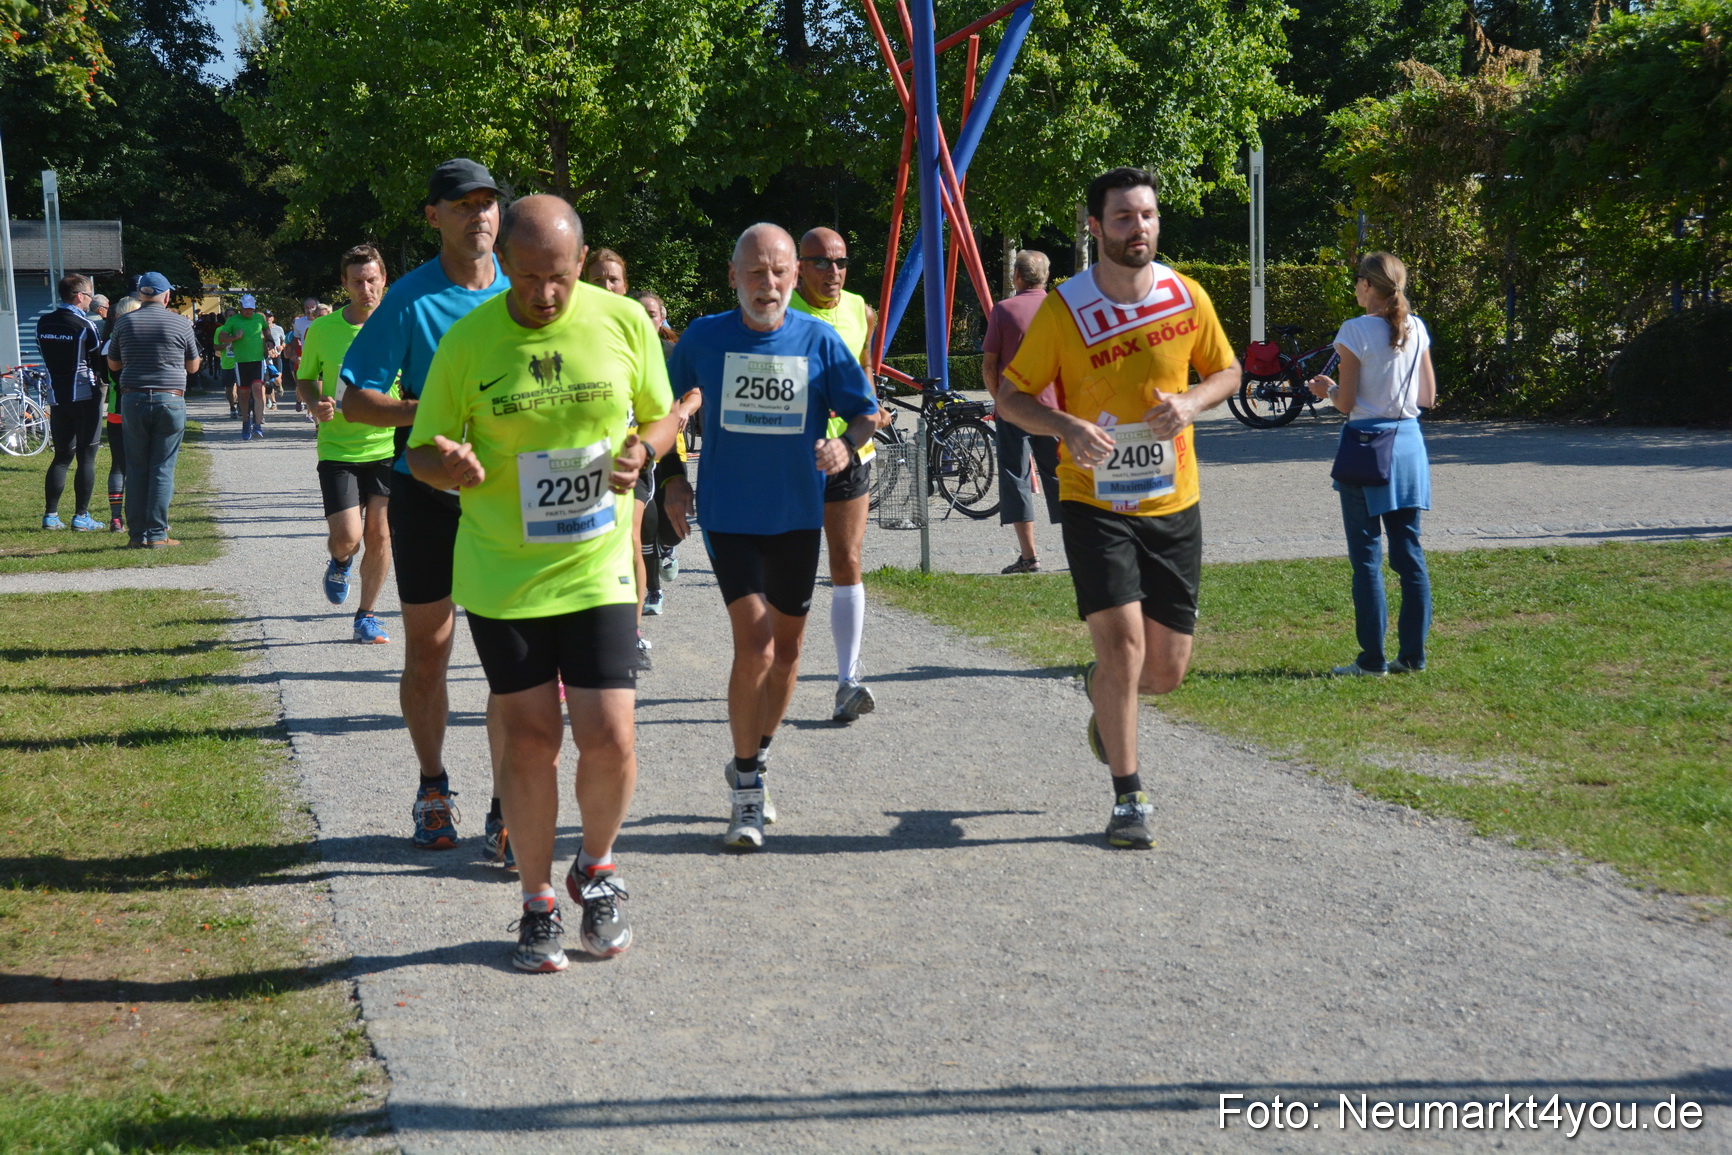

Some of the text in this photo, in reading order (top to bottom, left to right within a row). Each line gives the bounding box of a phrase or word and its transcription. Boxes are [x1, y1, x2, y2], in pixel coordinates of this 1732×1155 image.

[1090, 317, 1199, 369] MAX BÖGL
[734, 375, 795, 402] 2568
[492, 395, 509, 405] SC
[744, 413, 783, 425] Norbert
[1106, 443, 1164, 470] 2409
[536, 469, 603, 507] 2297
[1110, 479, 1163, 493] Maximilian
[556, 517, 596, 533] Robert
